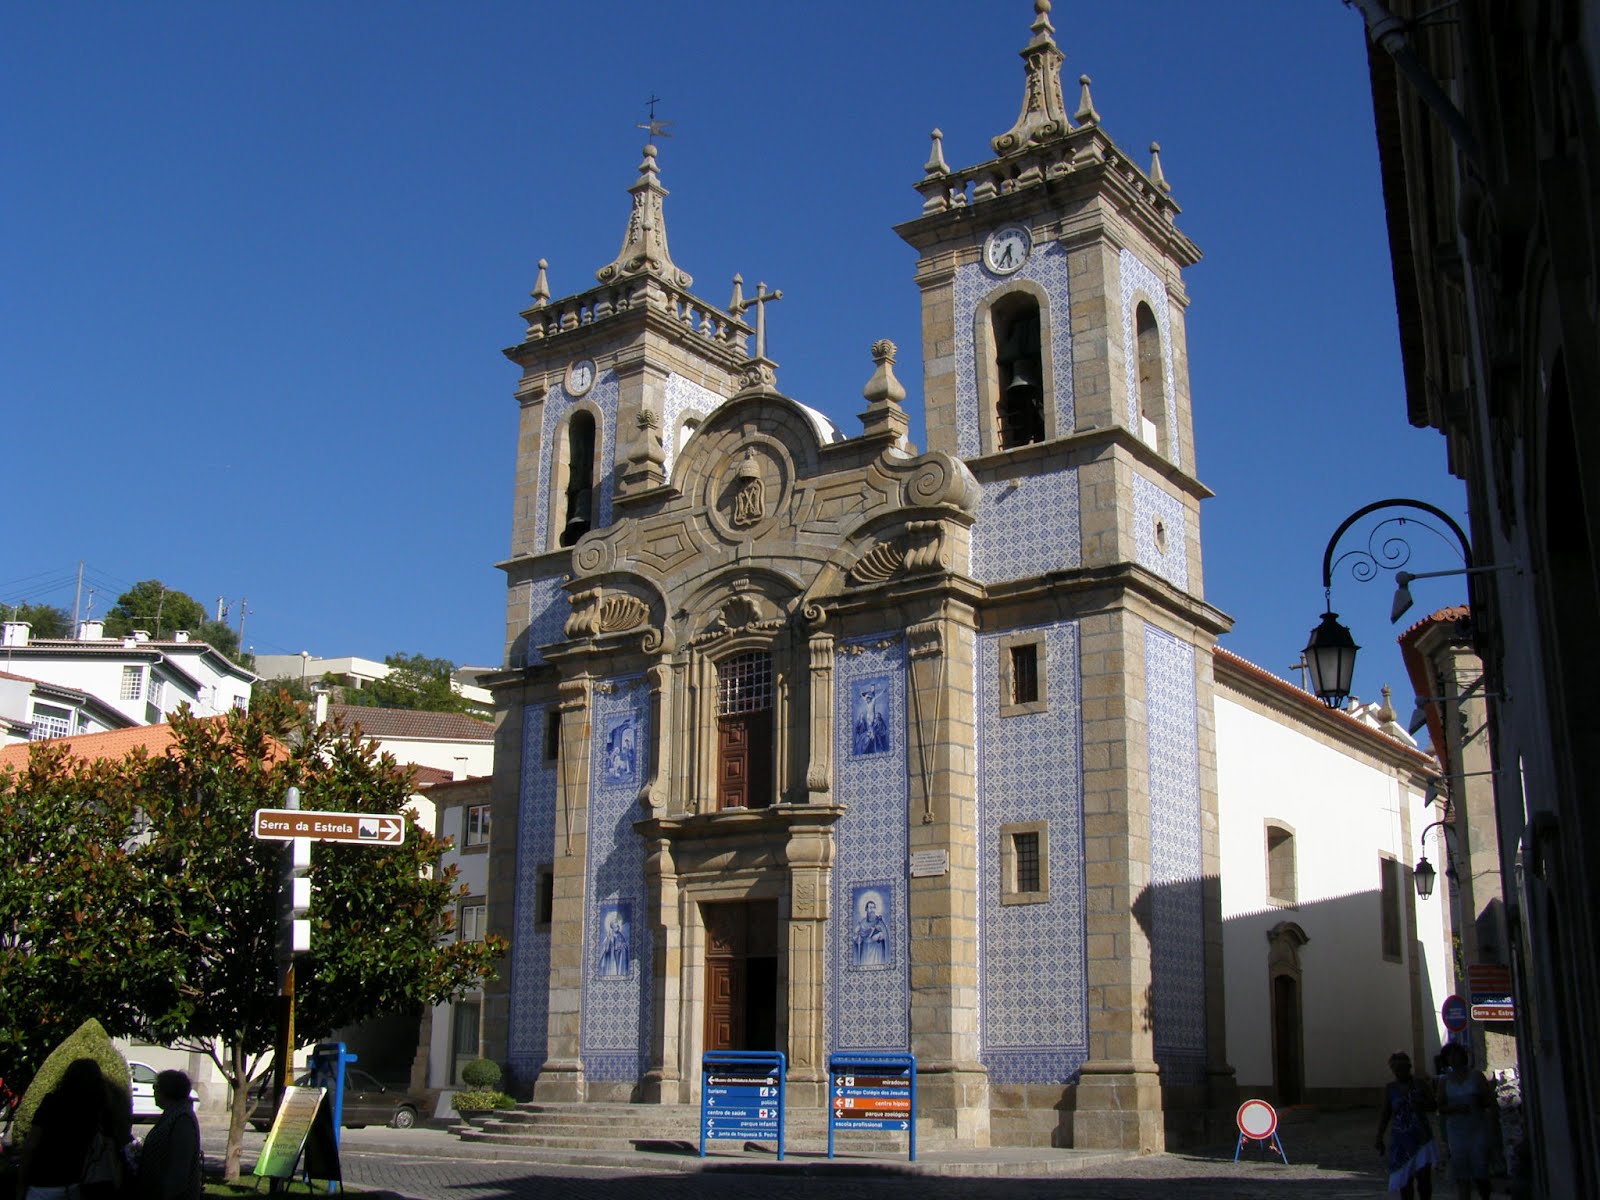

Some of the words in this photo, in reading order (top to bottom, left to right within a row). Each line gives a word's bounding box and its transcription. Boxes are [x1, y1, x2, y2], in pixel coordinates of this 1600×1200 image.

[259, 819, 290, 830] Serra
[295, 821, 309, 831] da
[314, 822, 353, 833] Estrela
